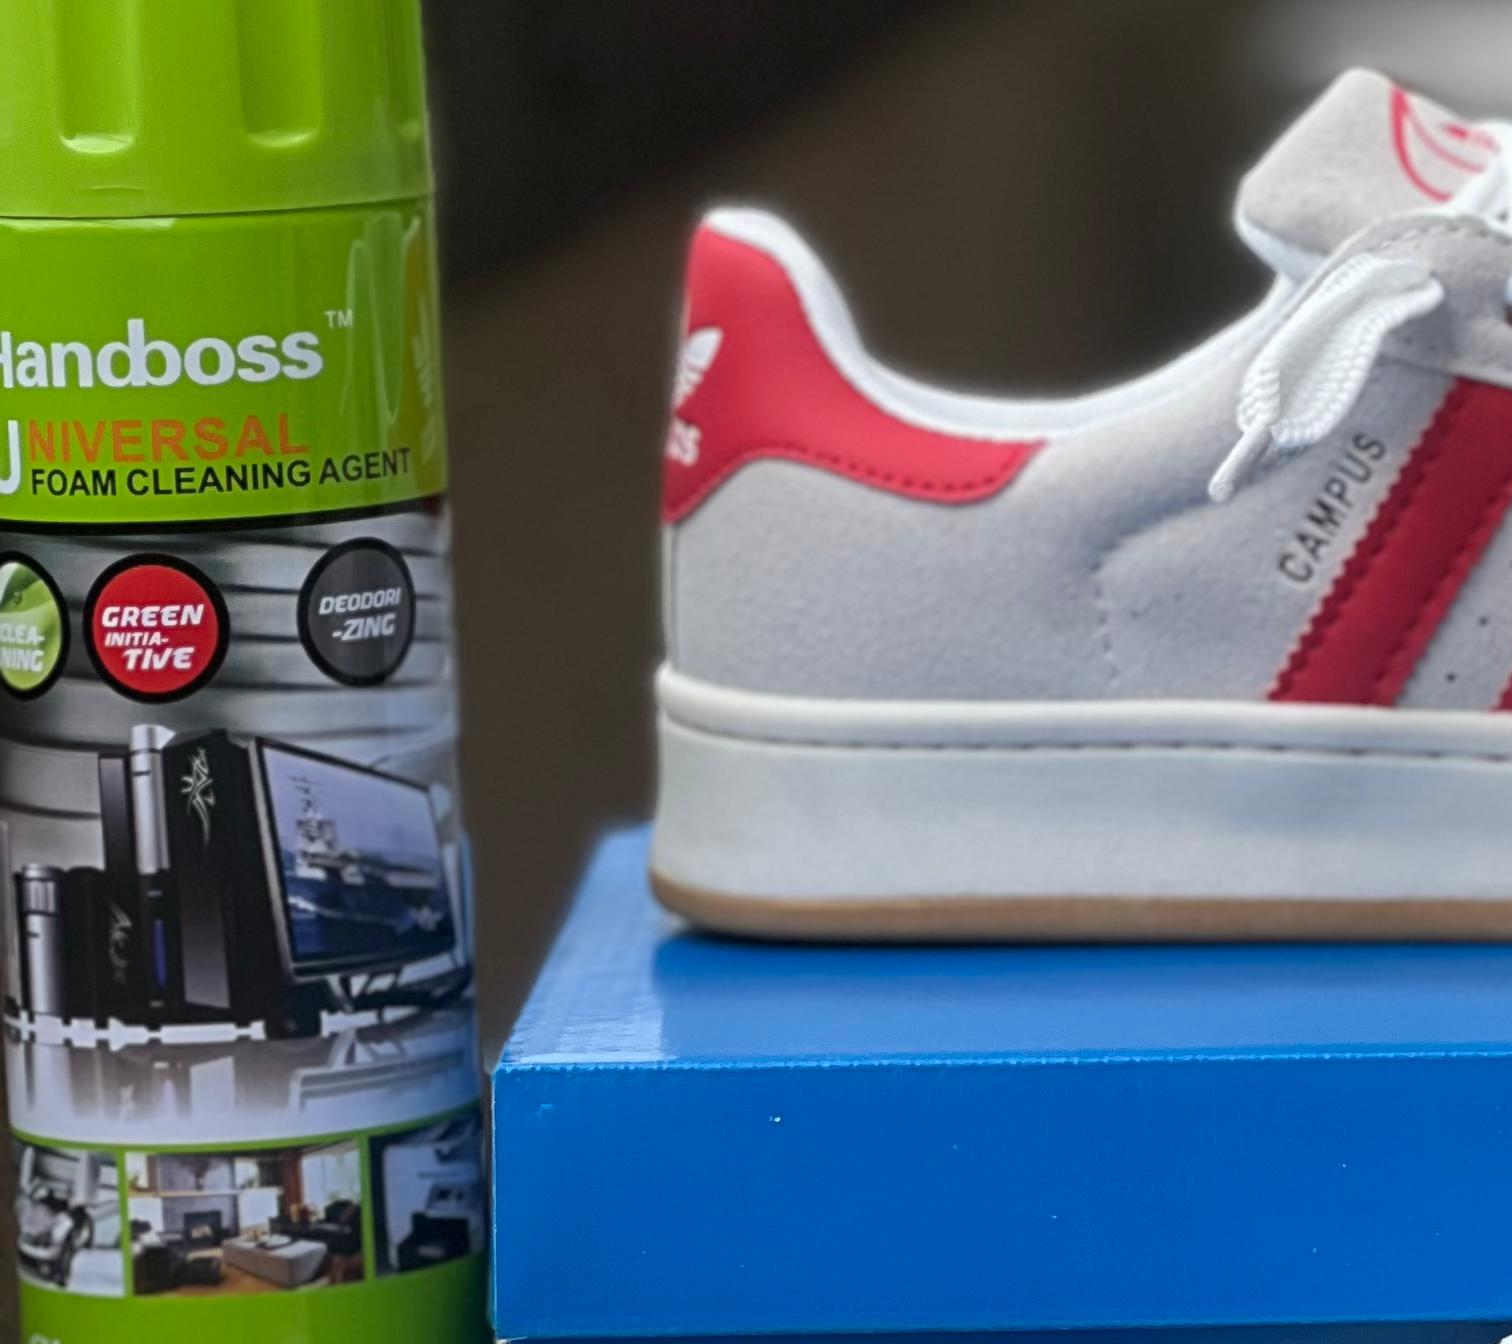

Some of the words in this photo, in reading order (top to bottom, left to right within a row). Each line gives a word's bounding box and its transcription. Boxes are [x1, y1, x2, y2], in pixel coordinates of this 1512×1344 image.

[31, 468, 117, 496] FOAM
[126, 459, 312, 496] CLEANING
[318, 447, 411, 486] AGENT
[1277, 431, 1388, 586] CAMPUS
[318, 586, 401, 615] DEODORI
[101, 603, 205, 628] GREEN
[104, 631, 169, 647] INITIA-
[122, 646, 195, 671] TIVE
